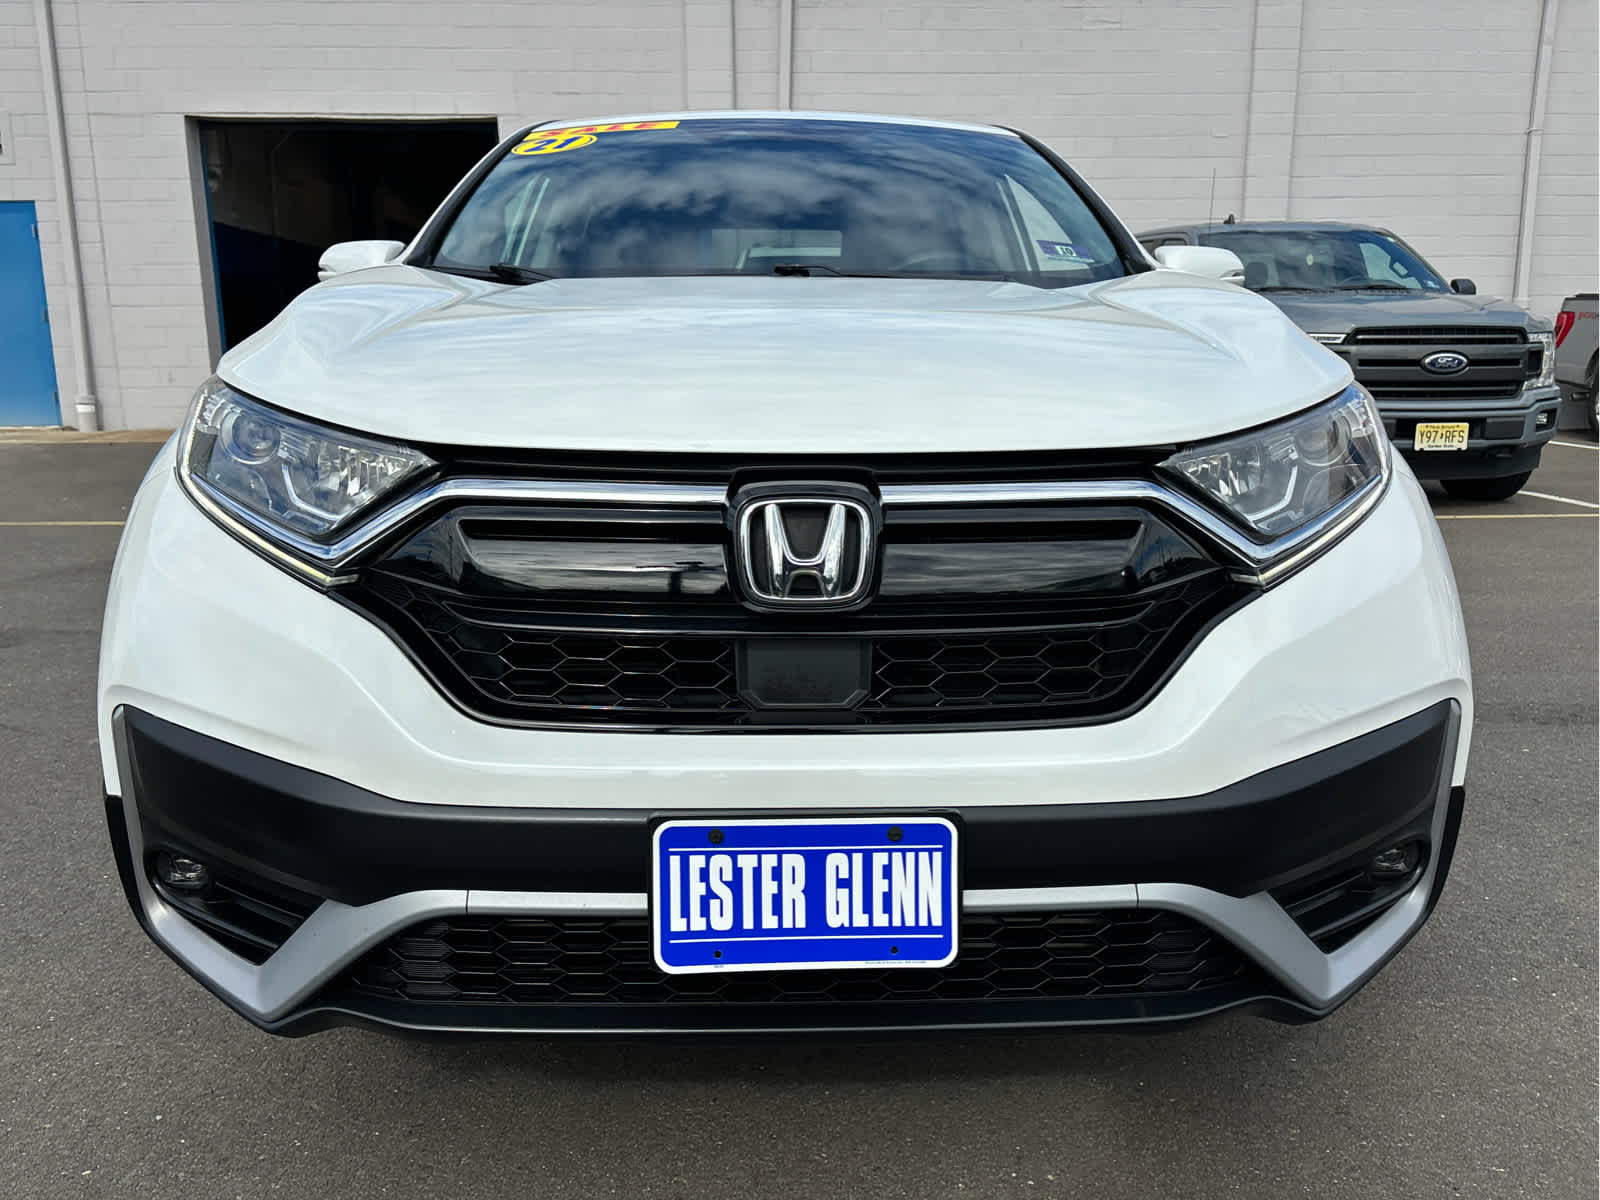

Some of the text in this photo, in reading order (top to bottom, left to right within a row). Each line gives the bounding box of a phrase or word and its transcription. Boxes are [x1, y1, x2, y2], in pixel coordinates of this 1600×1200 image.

[524, 135, 586, 152] 21
[669, 851, 943, 932] LESTER GLENN
